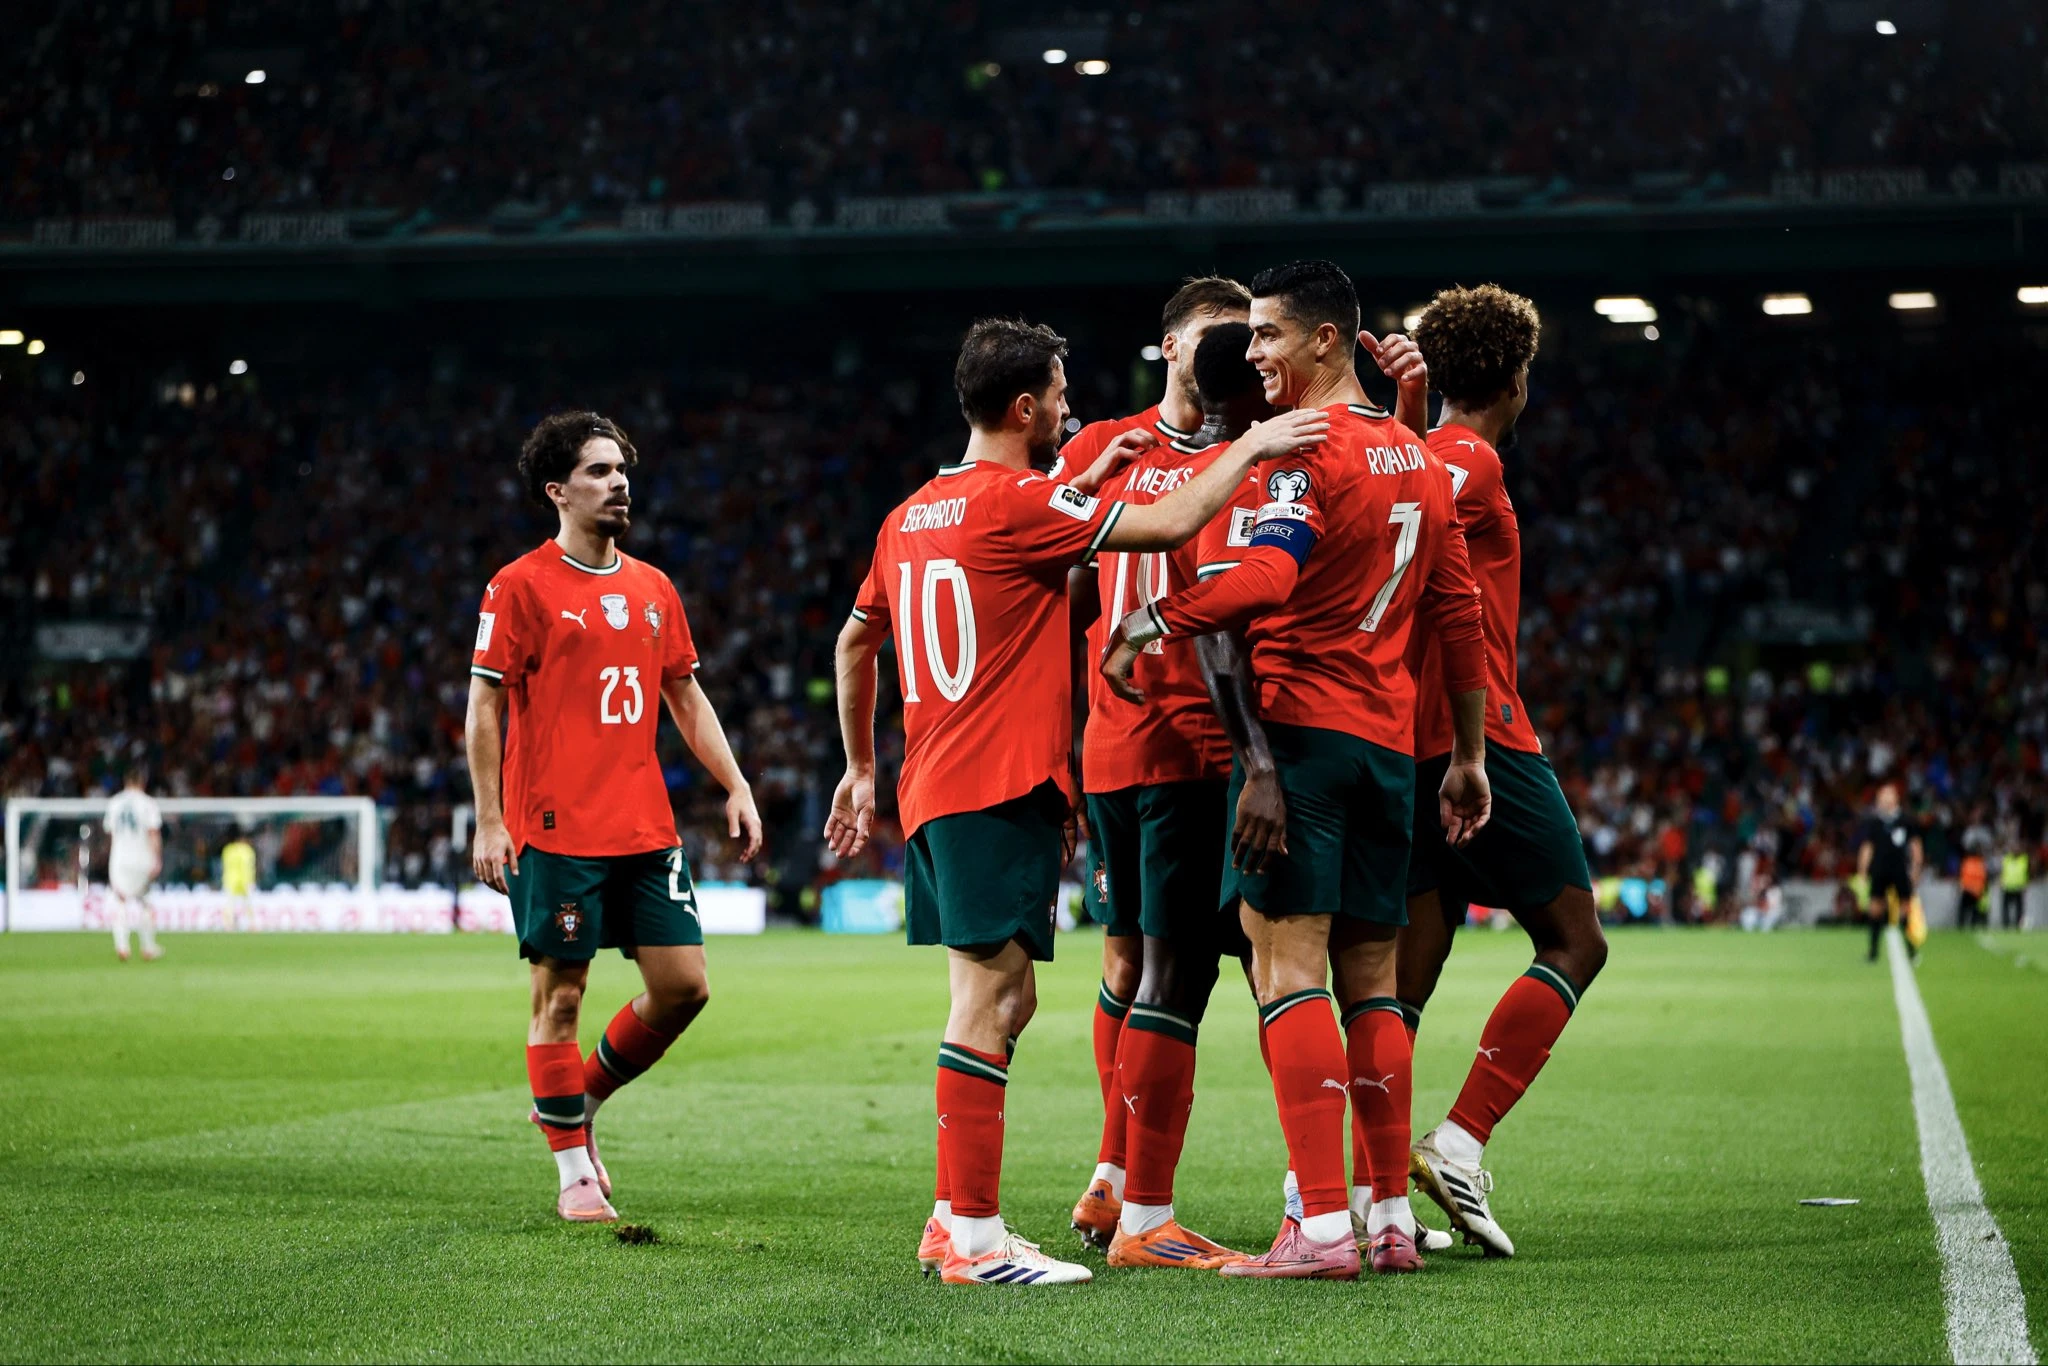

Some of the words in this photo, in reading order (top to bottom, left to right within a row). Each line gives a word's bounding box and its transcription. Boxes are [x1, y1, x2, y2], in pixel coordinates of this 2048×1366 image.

[900, 497, 967, 532] BERNARDO
[1254, 525, 1294, 538] RESPECT
[1357, 501, 1422, 633] 7
[898, 558, 977, 703] 10
[599, 666, 644, 725] 23
[666, 847, 694, 901] 2
